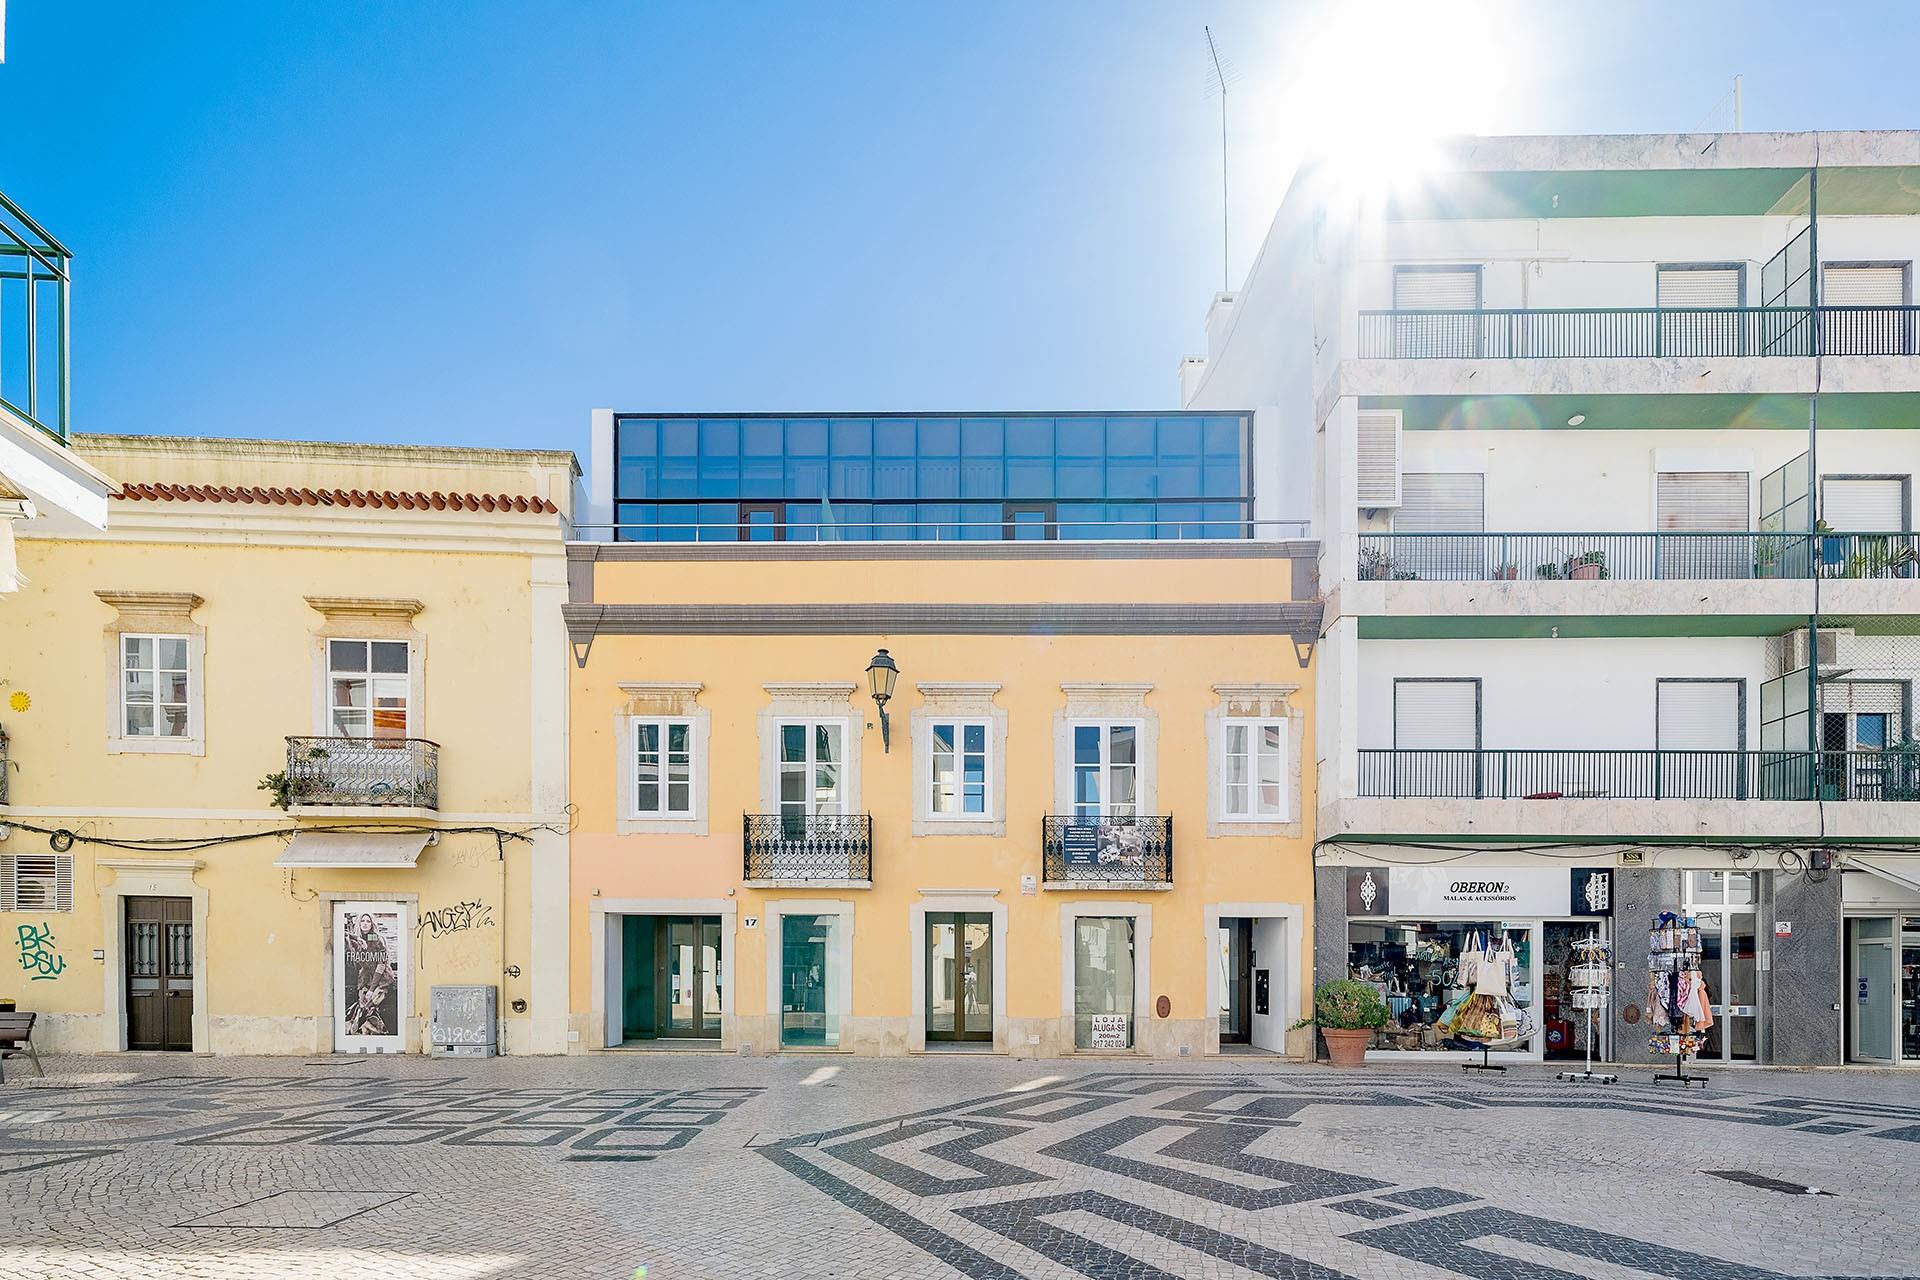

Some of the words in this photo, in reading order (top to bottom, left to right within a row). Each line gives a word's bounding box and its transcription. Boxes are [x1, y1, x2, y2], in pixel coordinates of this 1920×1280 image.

[745, 918, 758, 926] 17
[1093, 1023, 1126, 1032] ALUGA-SE
[1092, 1039, 1103, 1048] 917
[1104, 1039, 1114, 1048] 242
[1115, 1039, 1126, 1048] 024
